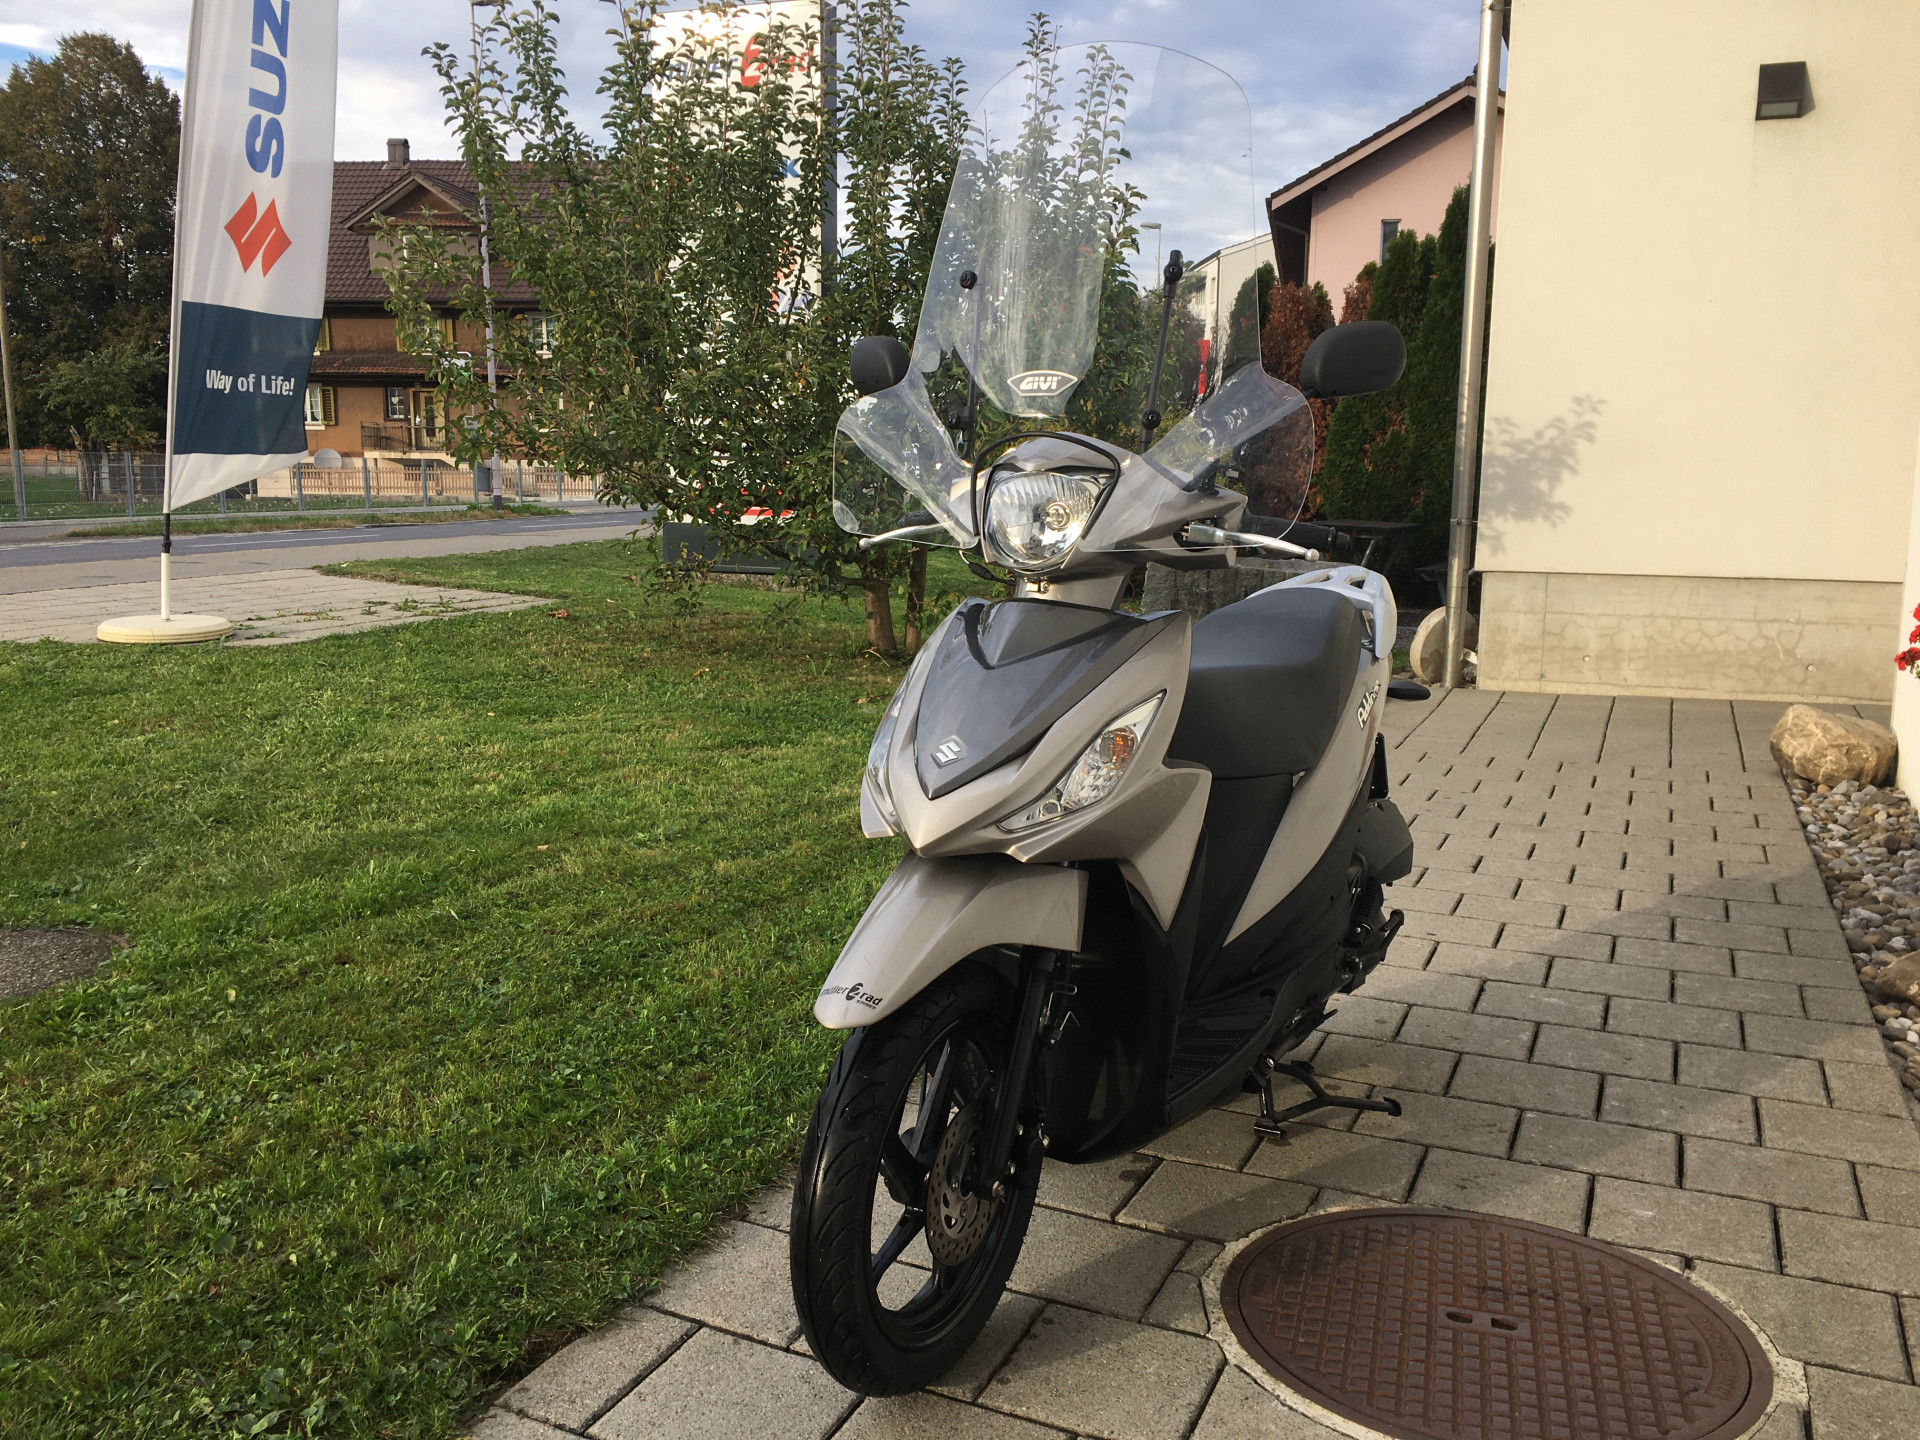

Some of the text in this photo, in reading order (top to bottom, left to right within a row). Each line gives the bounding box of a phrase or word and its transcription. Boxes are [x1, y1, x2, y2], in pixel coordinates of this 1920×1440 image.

[246, 0, 290, 178] SUZ
[205, 369, 295, 396] Way of Life!
[1020, 376, 1059, 390] GIVI
